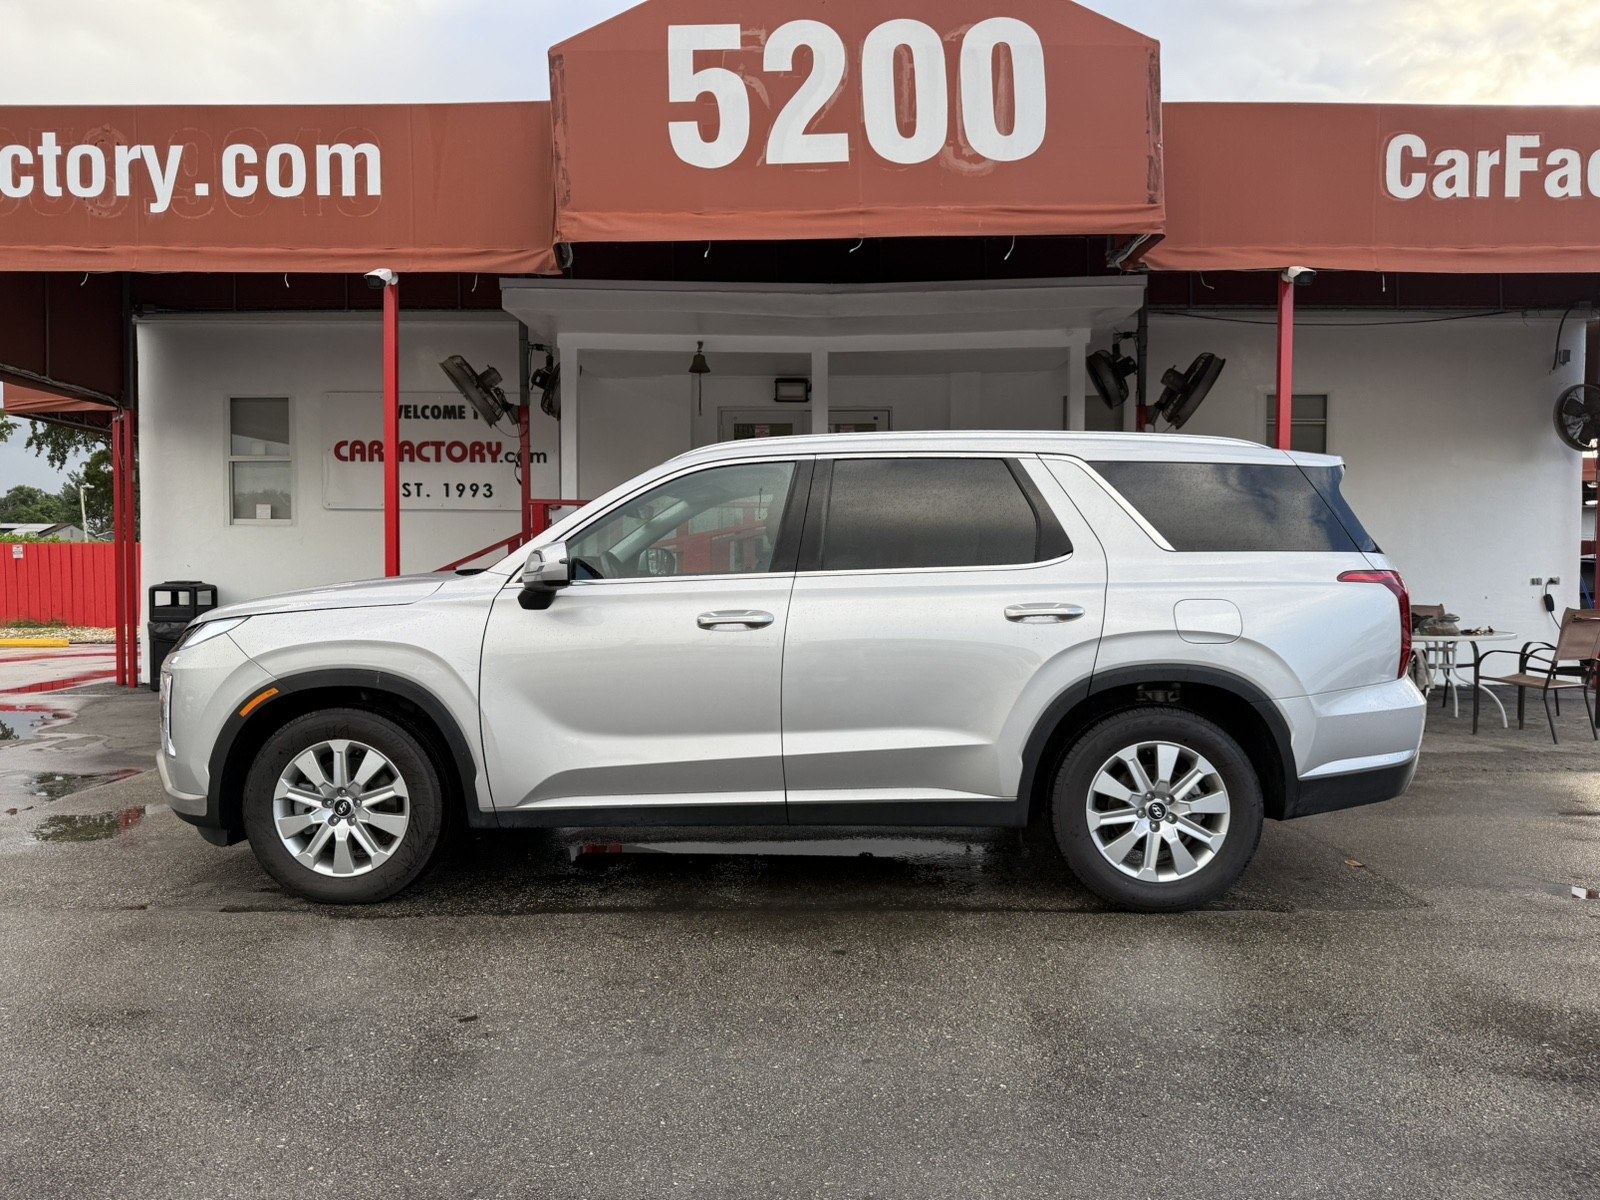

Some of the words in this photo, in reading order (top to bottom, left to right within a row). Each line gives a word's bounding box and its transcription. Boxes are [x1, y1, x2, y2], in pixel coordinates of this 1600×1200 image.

[668, 17, 1047, 169] 5200
[0, 132, 383, 214] ctory.com
[334, 440, 547, 464] CARACTORY.cm
[402, 482, 431, 498] ST.
[444, 483, 494, 498] 1993
